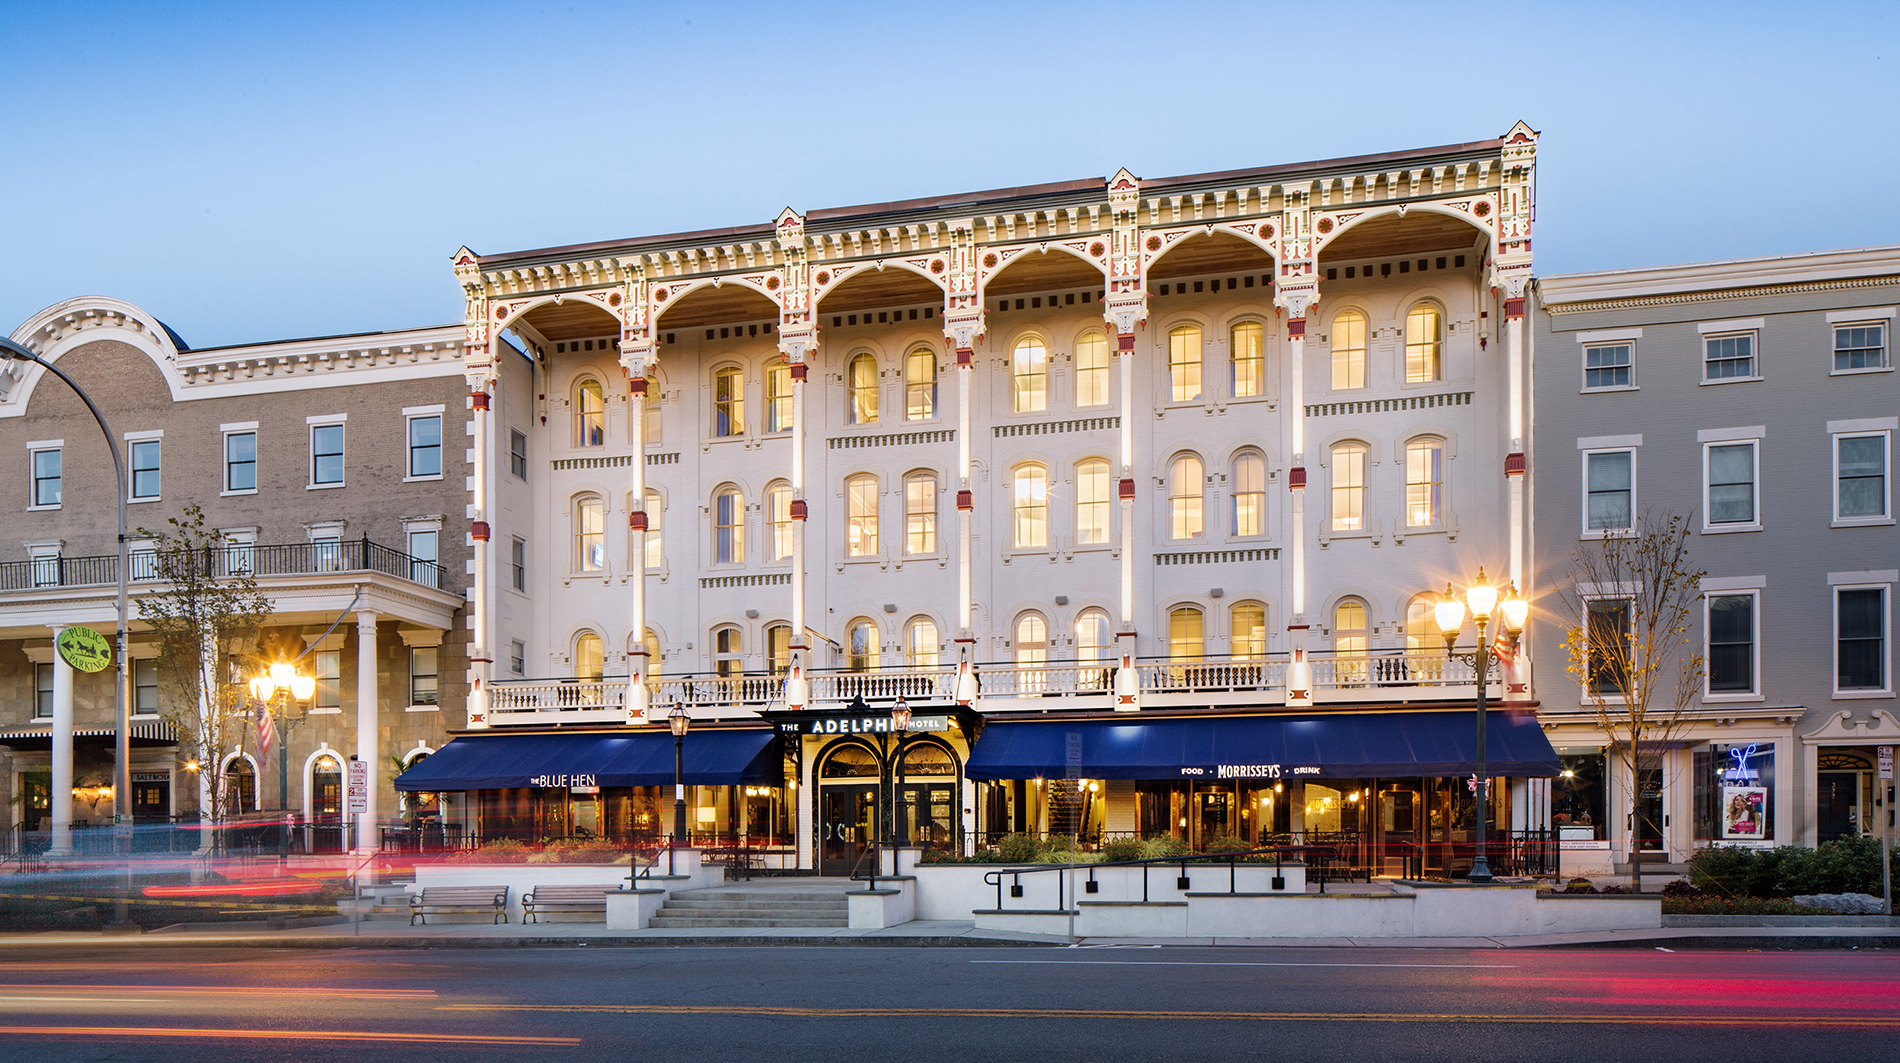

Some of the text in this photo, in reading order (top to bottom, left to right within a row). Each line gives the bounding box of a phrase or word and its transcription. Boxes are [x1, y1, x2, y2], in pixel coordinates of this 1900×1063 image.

[69, 627, 102, 644] PUBLIC
[69, 653, 105, 671] PARKING
[781, 723, 799, 731] THE
[908, 720, 940, 728] HOTEL
[1181, 767, 1204, 775] FOOD
[1294, 766, 1320, 774] DRINK
[540, 774, 568, 787] BLUE
[570, 774, 595, 787] HEN
